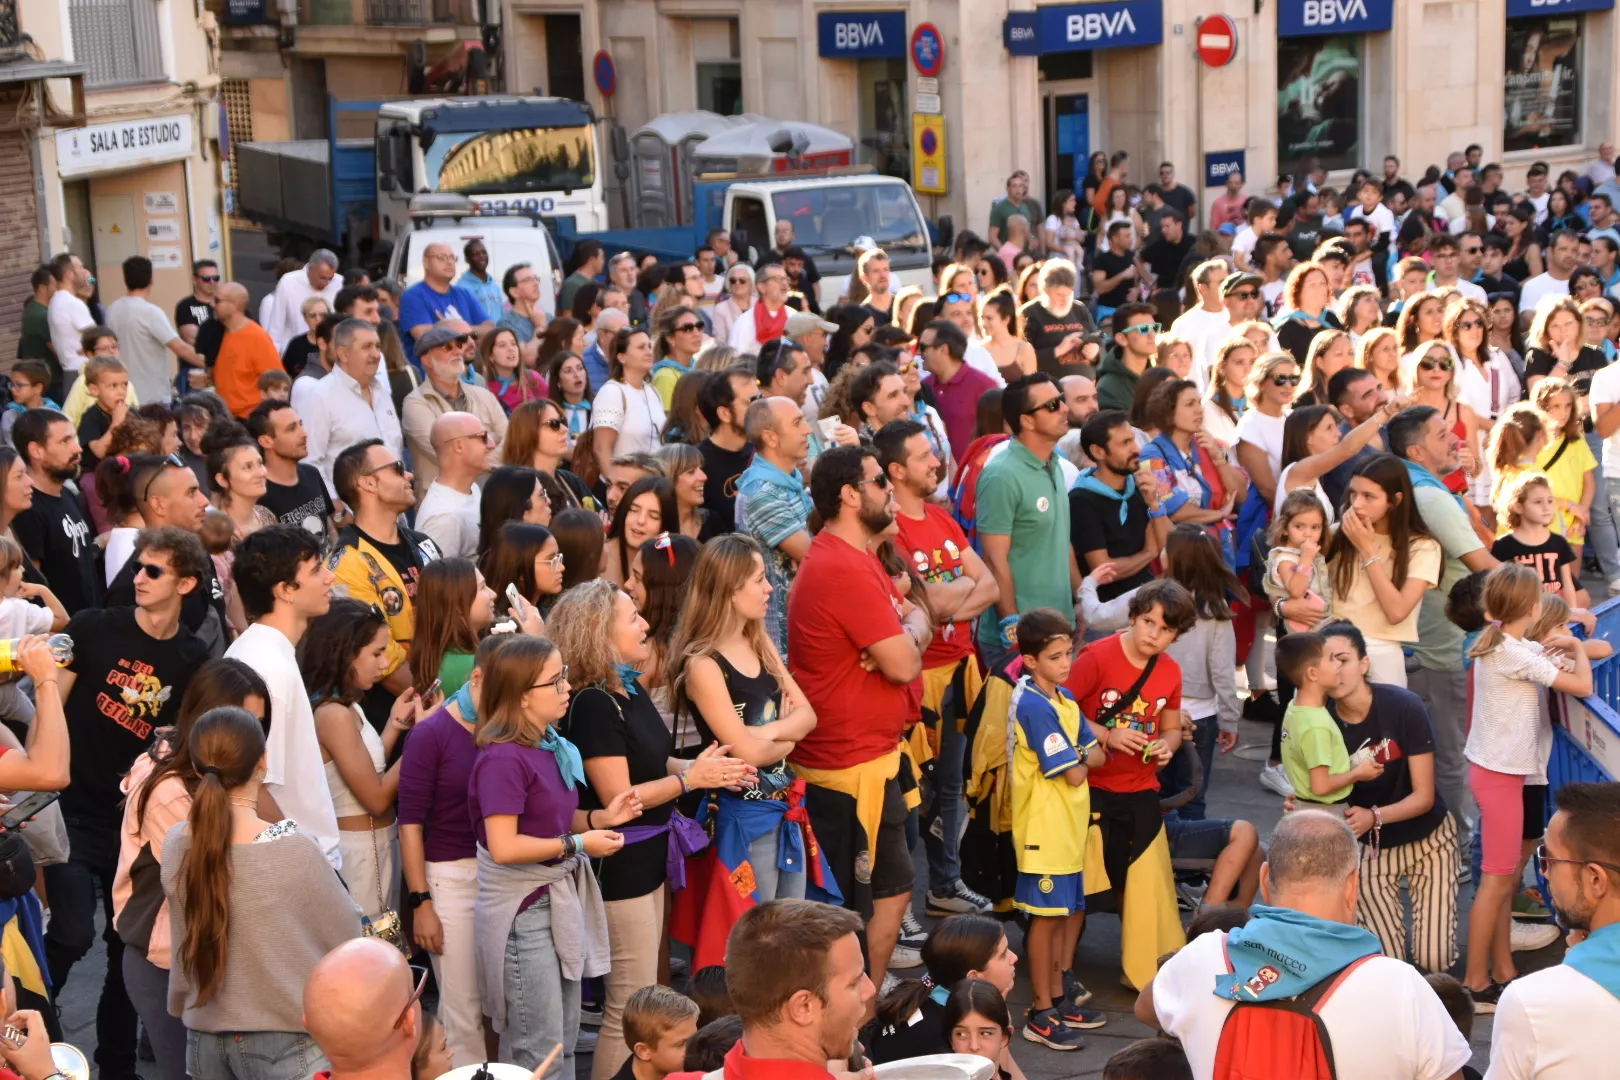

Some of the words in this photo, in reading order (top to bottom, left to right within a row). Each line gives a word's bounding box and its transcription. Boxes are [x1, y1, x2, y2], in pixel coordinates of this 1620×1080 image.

[1066, 8, 1136, 42] BBVA
[1303, 0, 1368, 27] BBVA
[835, 20, 884, 49] BBVA
[1010, 27, 1034, 41] BBVA
[90, 130, 118, 153] SALA
[122, 128, 135, 149] DE
[139, 121, 180, 146] ESTUDIO
[1210, 161, 1240, 177] BBVA
[1044, 324, 1065, 333] SIGO
[132, 660, 154, 676] DEL
[96, 691, 152, 740] RETURNS
[1244, 940, 1265, 952] san
[1267, 947, 1307, 973] mateo
